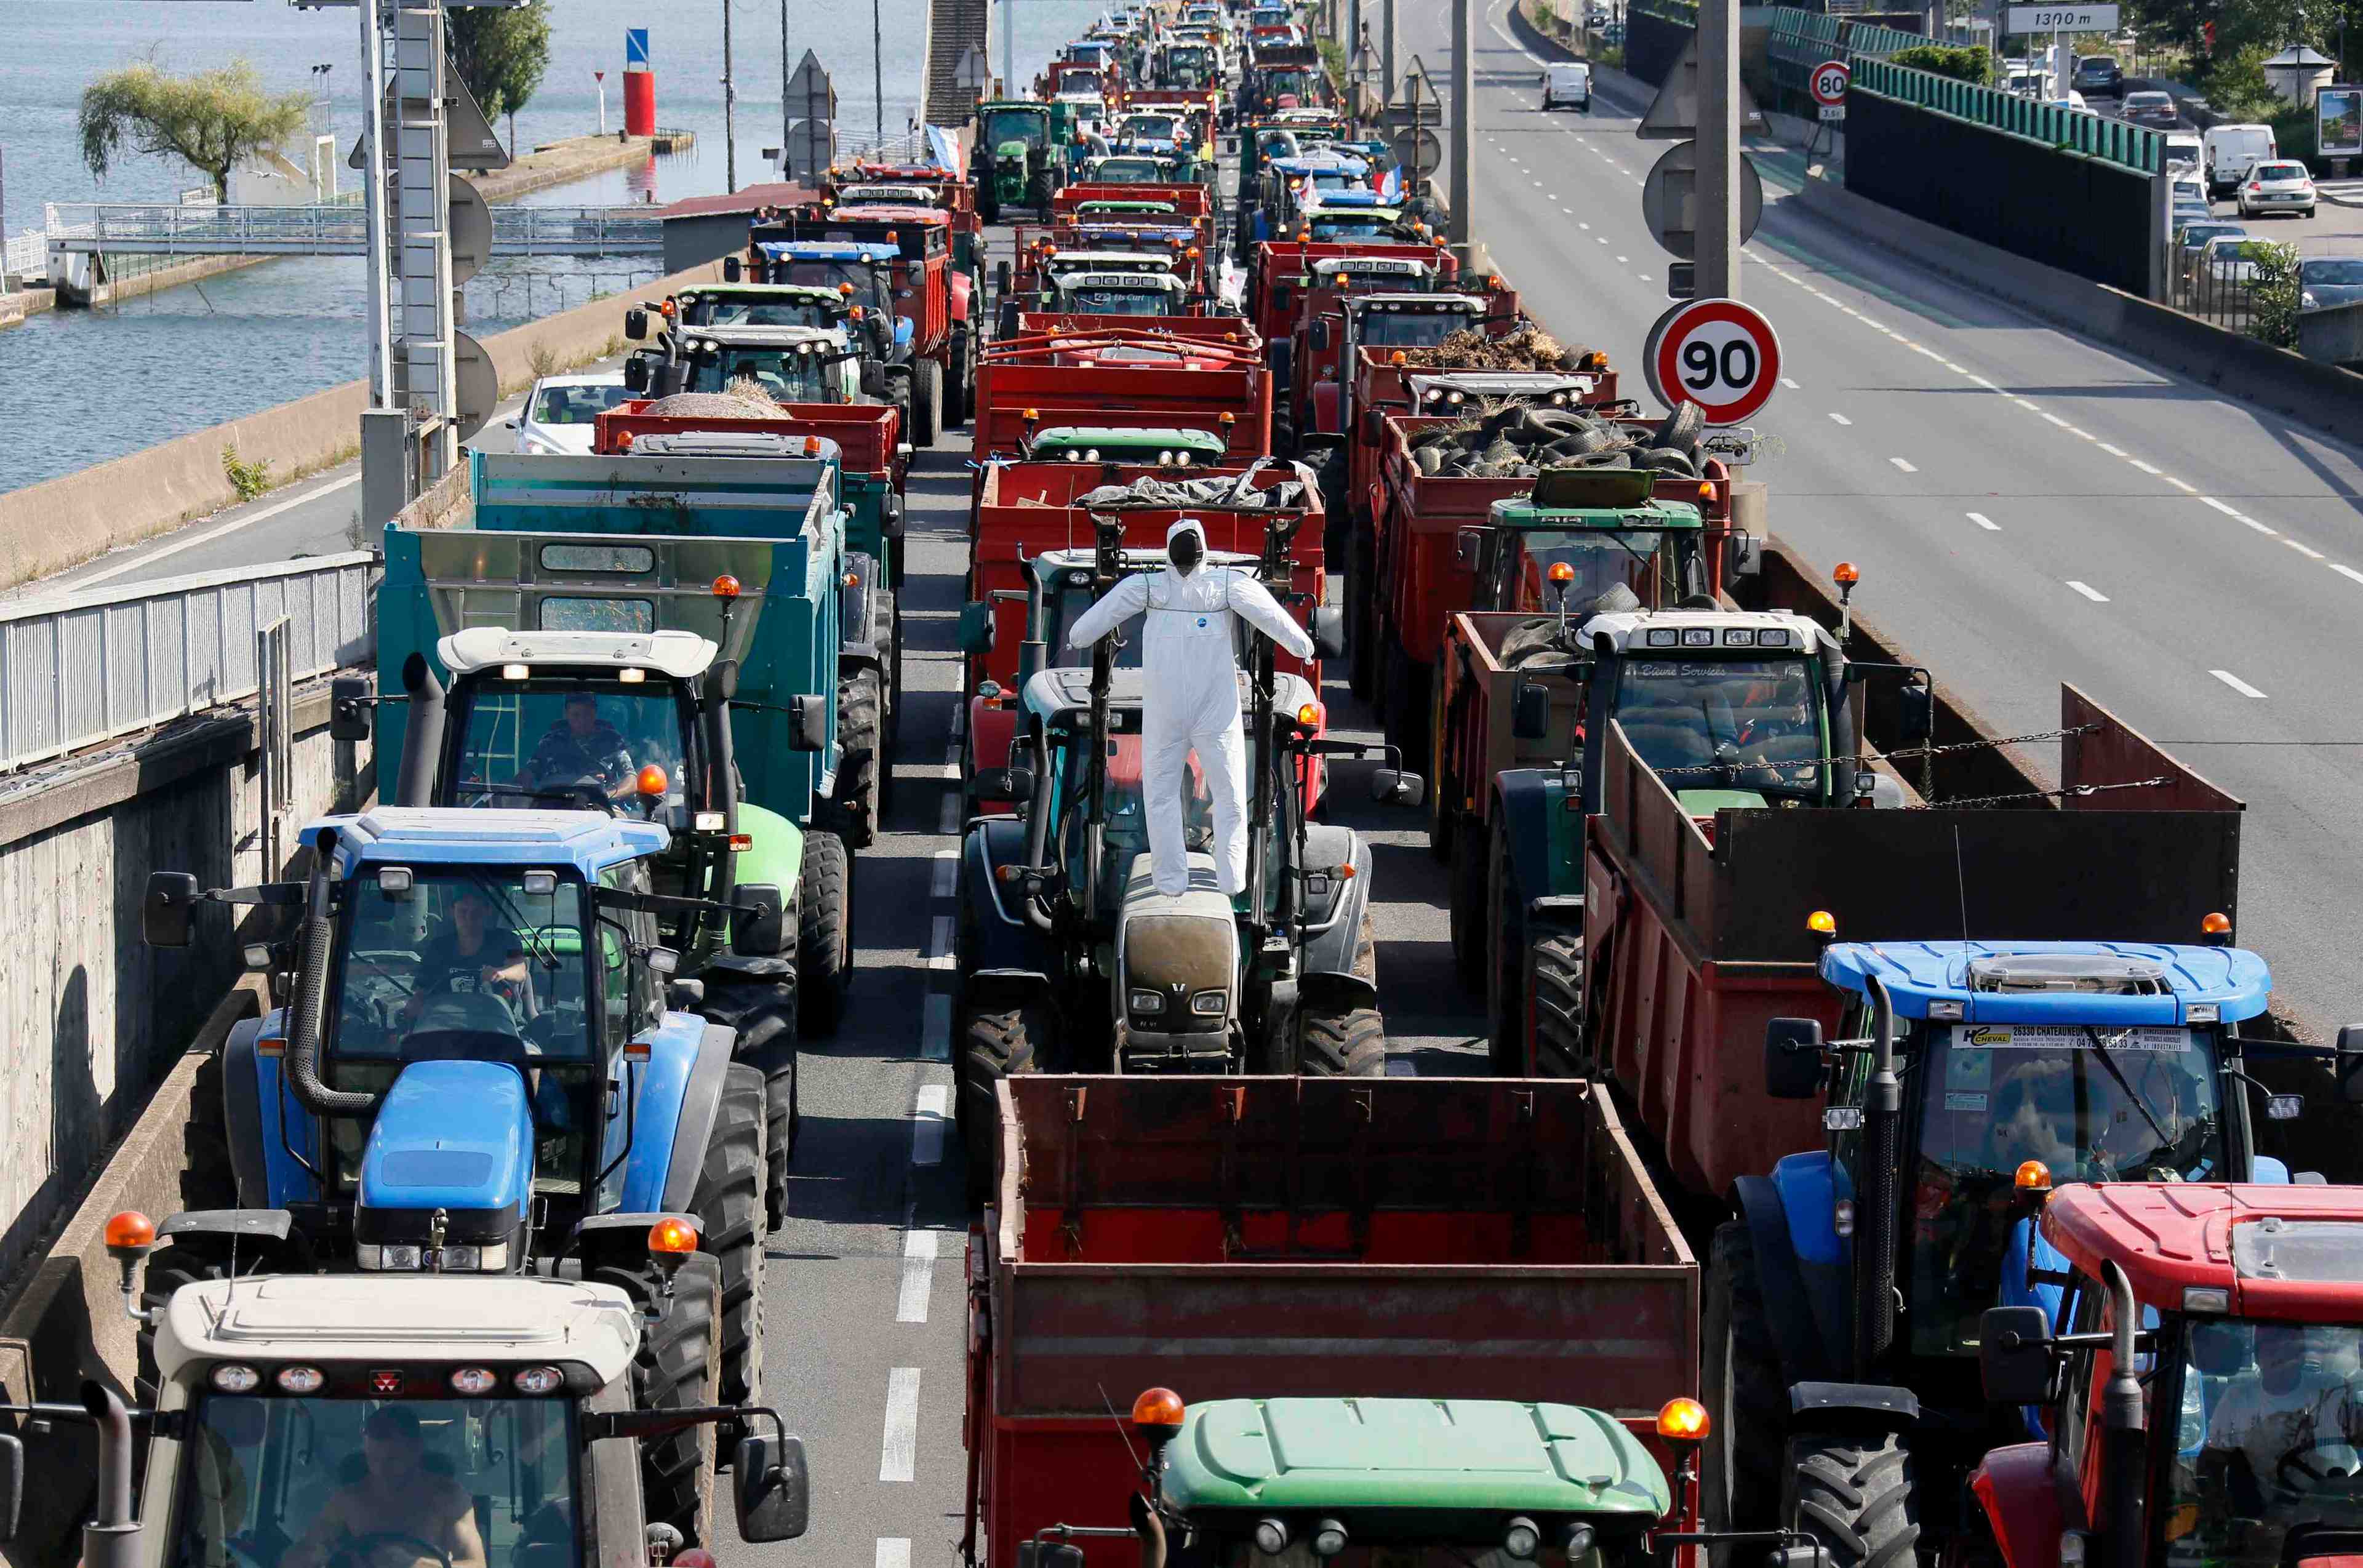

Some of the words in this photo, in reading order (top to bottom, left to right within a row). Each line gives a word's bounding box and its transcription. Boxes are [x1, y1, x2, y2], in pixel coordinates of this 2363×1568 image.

[2036, 12, 2074, 25] 1300
[2078, 14, 2091, 25] m
[1820, 76, 1844, 94] 80
[1683, 340, 1755, 390] 90
[1681, 665, 1726, 676] Services
[2013, 1026, 2034, 1036] 26330
[2077, 1038, 2085, 1047] 04
[2108, 1039, 2117, 1048] 63
[2119, 1039, 2127, 1048] 33
